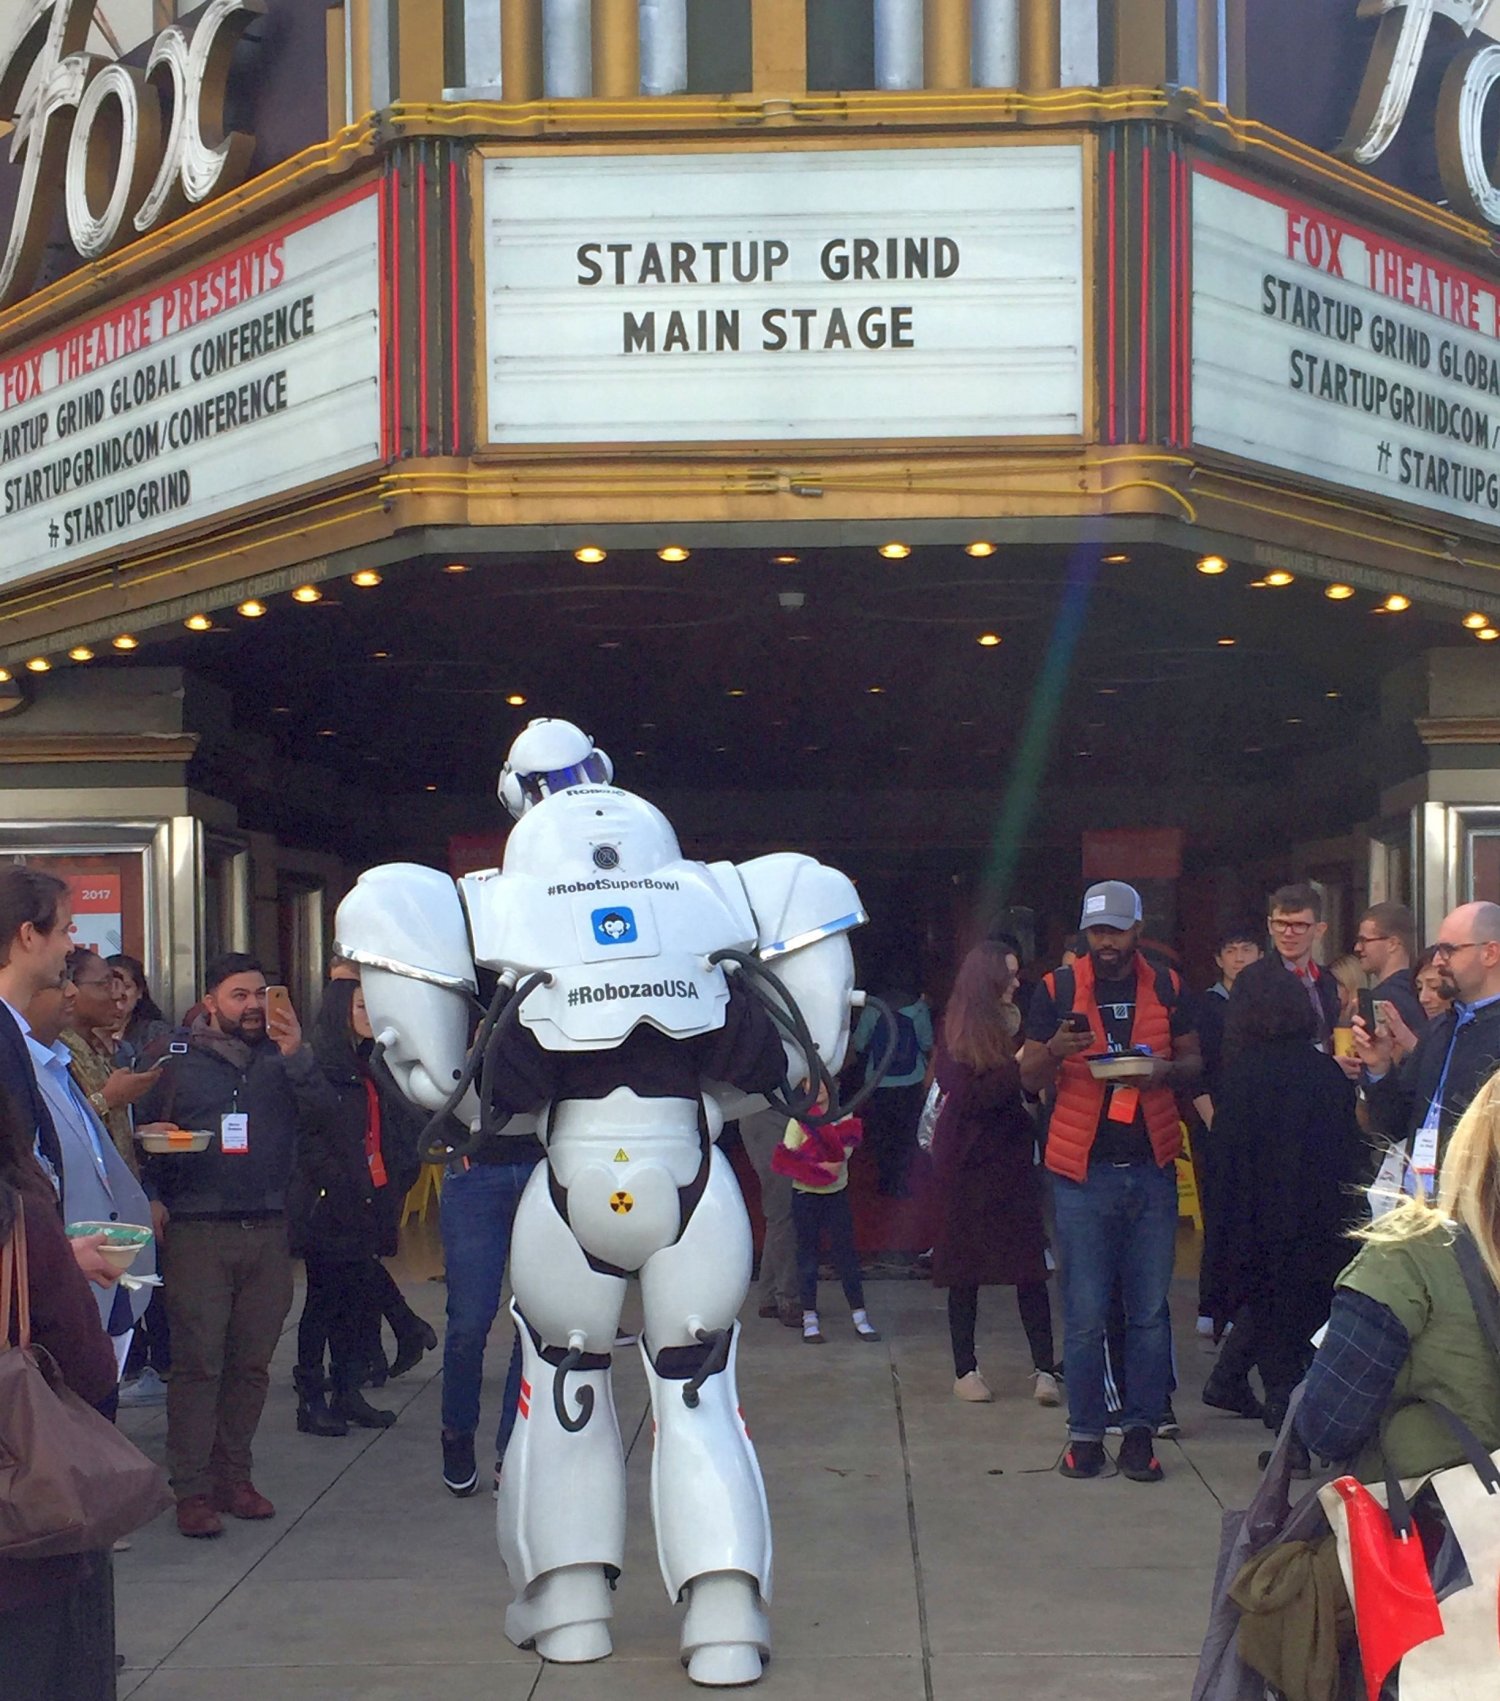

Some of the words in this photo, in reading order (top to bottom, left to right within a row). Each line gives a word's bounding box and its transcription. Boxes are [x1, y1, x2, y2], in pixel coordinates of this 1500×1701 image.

[576, 240, 789, 286] STARTUP
[820, 237, 960, 281] GRIND
[1287, 211, 1345, 280] FOX
[1366, 250, 1480, 332] THEATRE
[5, 355, 42, 409] FOX
[56, 308, 151, 385] THEATRE
[162, 242, 285, 337] PRESENTS
[623, 309, 740, 353] MAIN
[761, 307, 915, 350] STAGE
[1262, 274, 1363, 344] STARTUP
[1370, 315, 1431, 369] GRIND
[0, 412, 49, 462] ARTUP
[56, 388, 105, 439] GRIND
[110, 355, 181, 415] GLOBAL
[190, 295, 314, 381] CONFERENCE
[209, 583, 245, 603] MATEO
[247, 574, 286, 596] CREDIT
[290, 559, 328, 584] UNION
[82, 889, 111, 900] 2017
[547, 878, 680, 896] #RobotSuperBowl
[567, 980, 699, 1007] #RobozaoUSA
